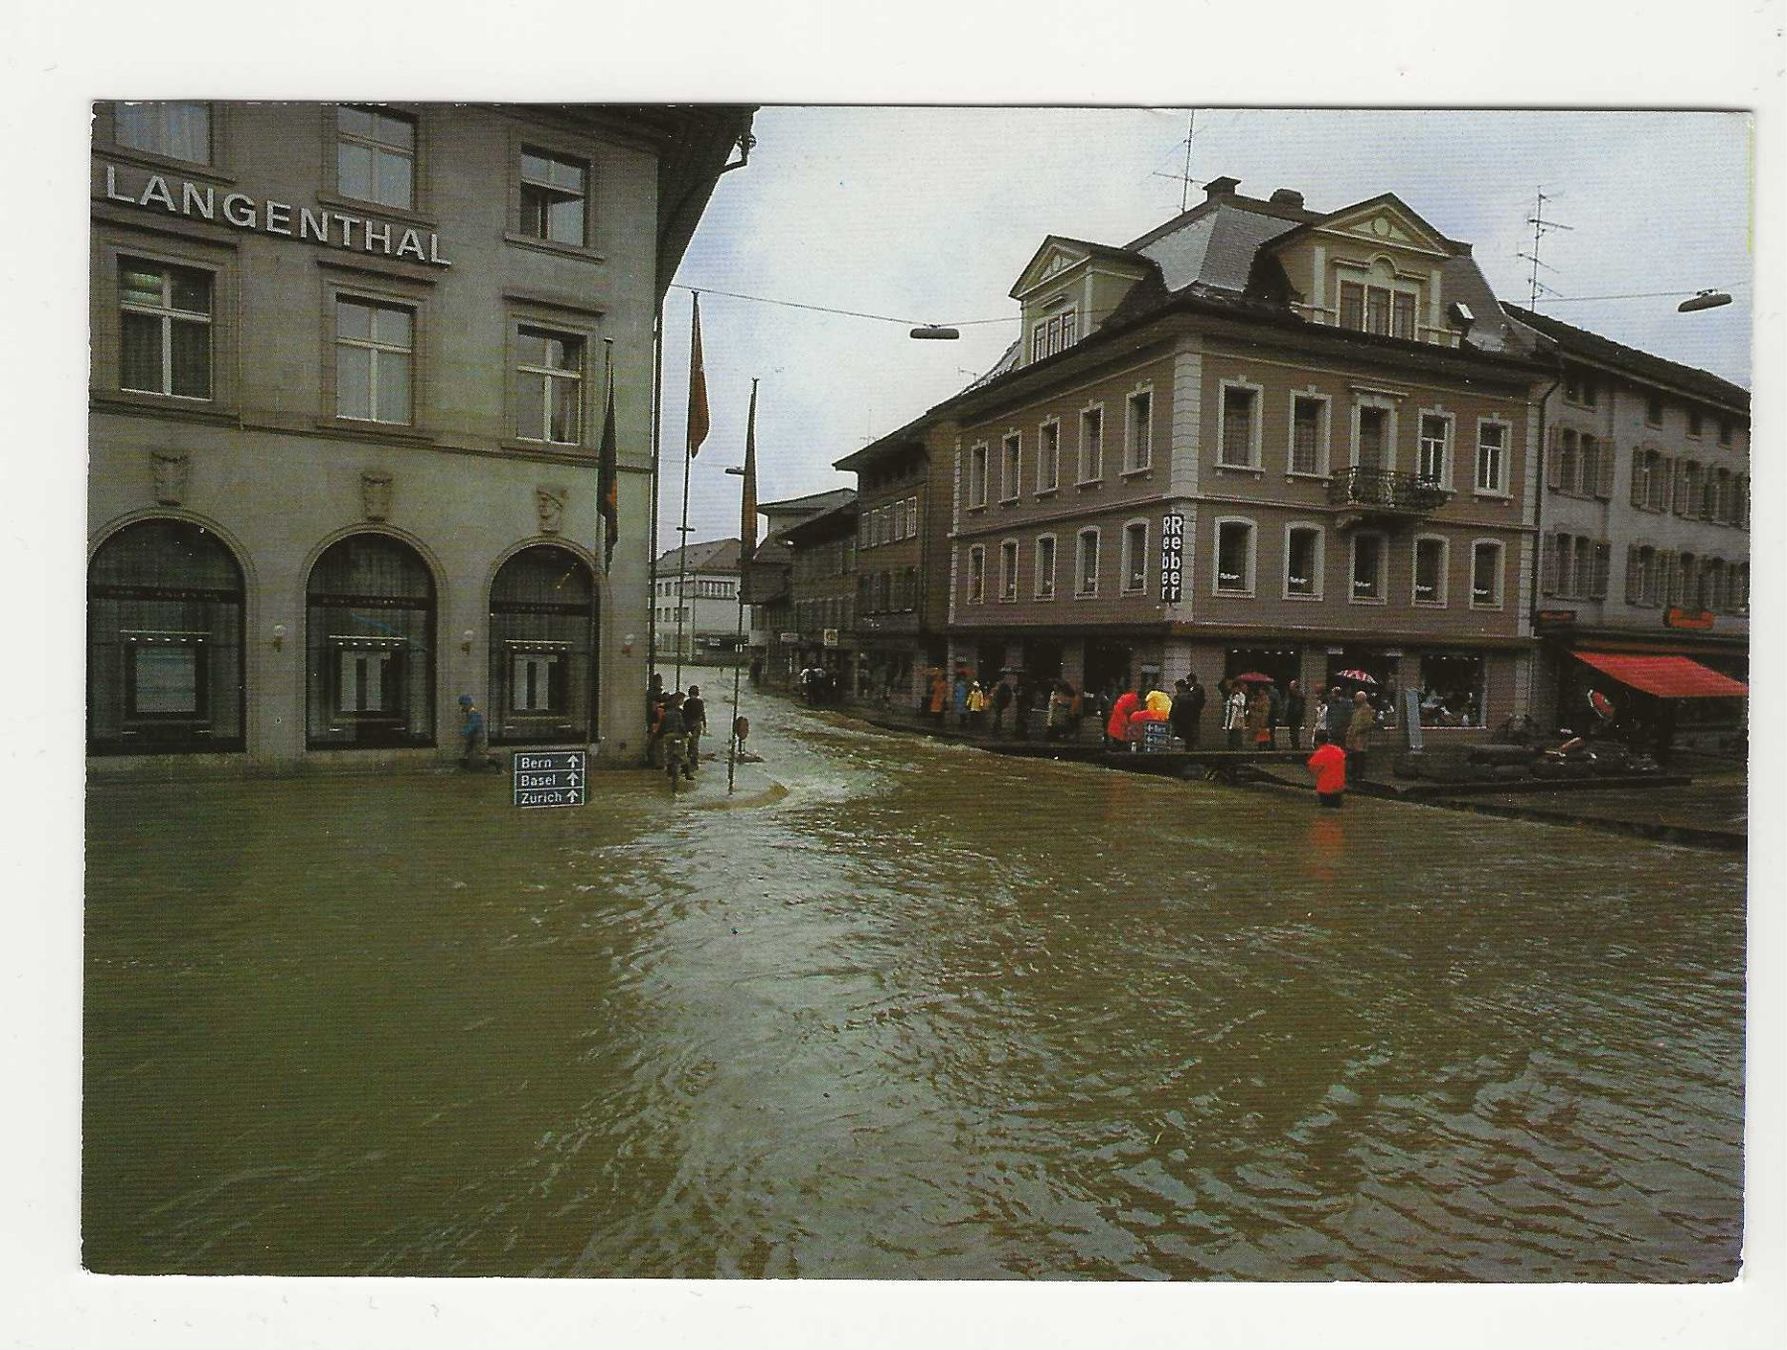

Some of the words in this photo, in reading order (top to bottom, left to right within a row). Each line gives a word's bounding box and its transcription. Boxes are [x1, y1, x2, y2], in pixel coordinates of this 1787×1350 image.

[106, 165, 452, 265] LANGENTHAL
[1161, 516, 1171, 600] Reber
[1170, 516, 1183, 600] Reber
[521, 757, 552, 769] Bern
[521, 773, 556, 787] Basel
